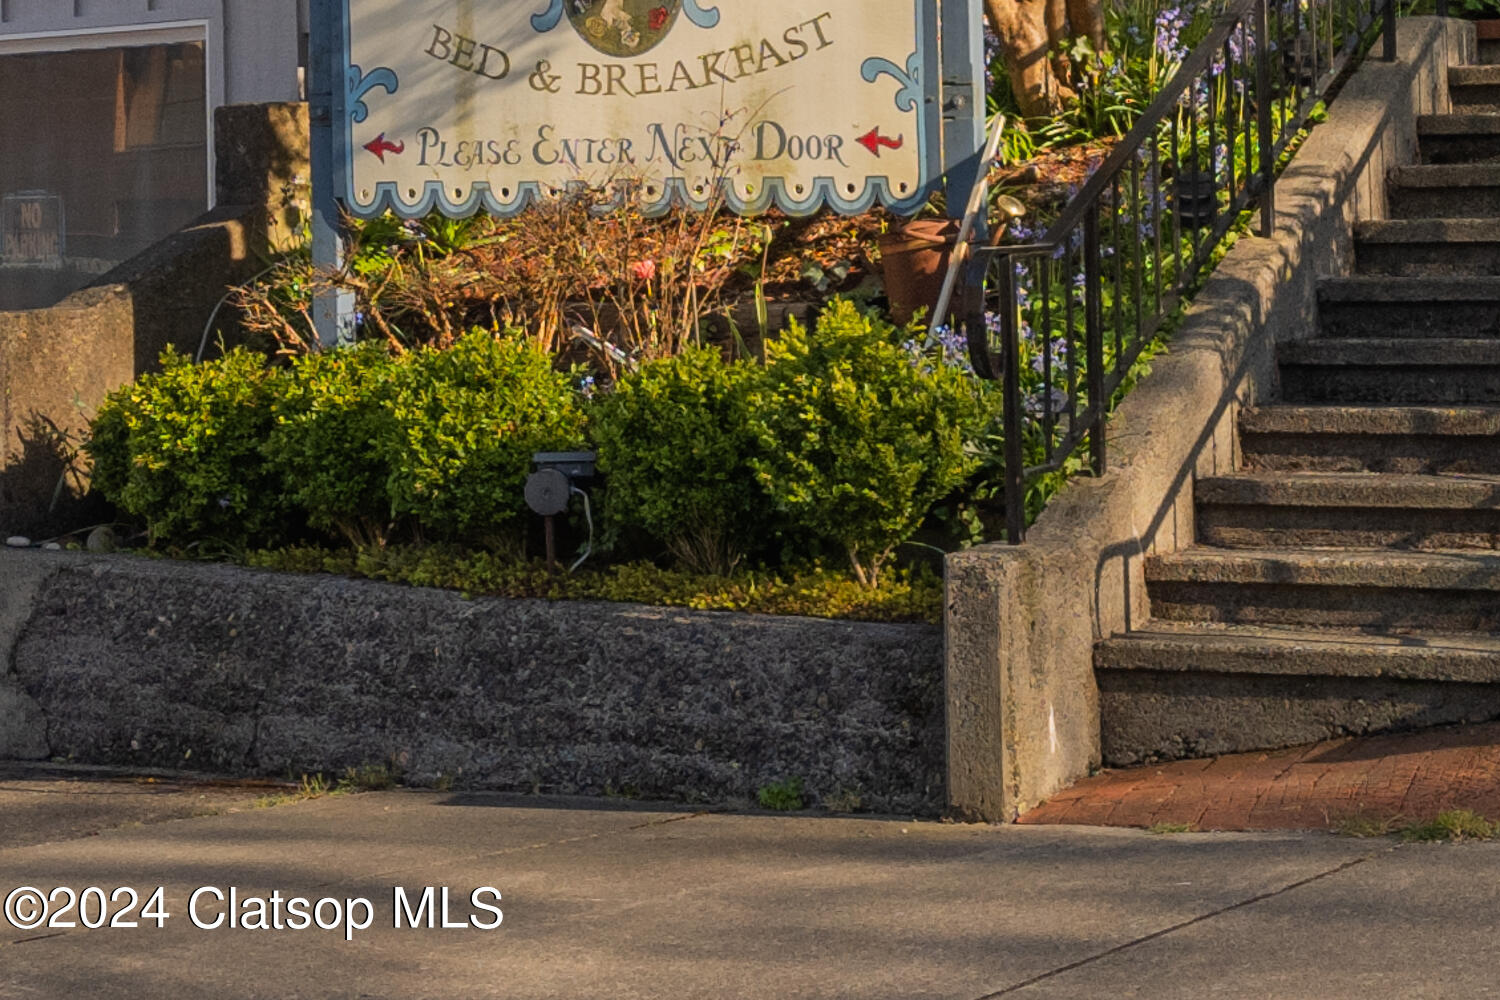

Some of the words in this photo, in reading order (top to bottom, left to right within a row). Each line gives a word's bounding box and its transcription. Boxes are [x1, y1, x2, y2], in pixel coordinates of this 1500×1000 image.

[424, 24, 510, 80] BED
[528, 60, 561, 94] &
[575, 12, 834, 97] BREAKFAST
[415, 126, 522, 170] PLEASE
[532, 124, 635, 168] ENTER
[752, 120, 849, 167] DOOR
[20, 203, 41, 228] NO
